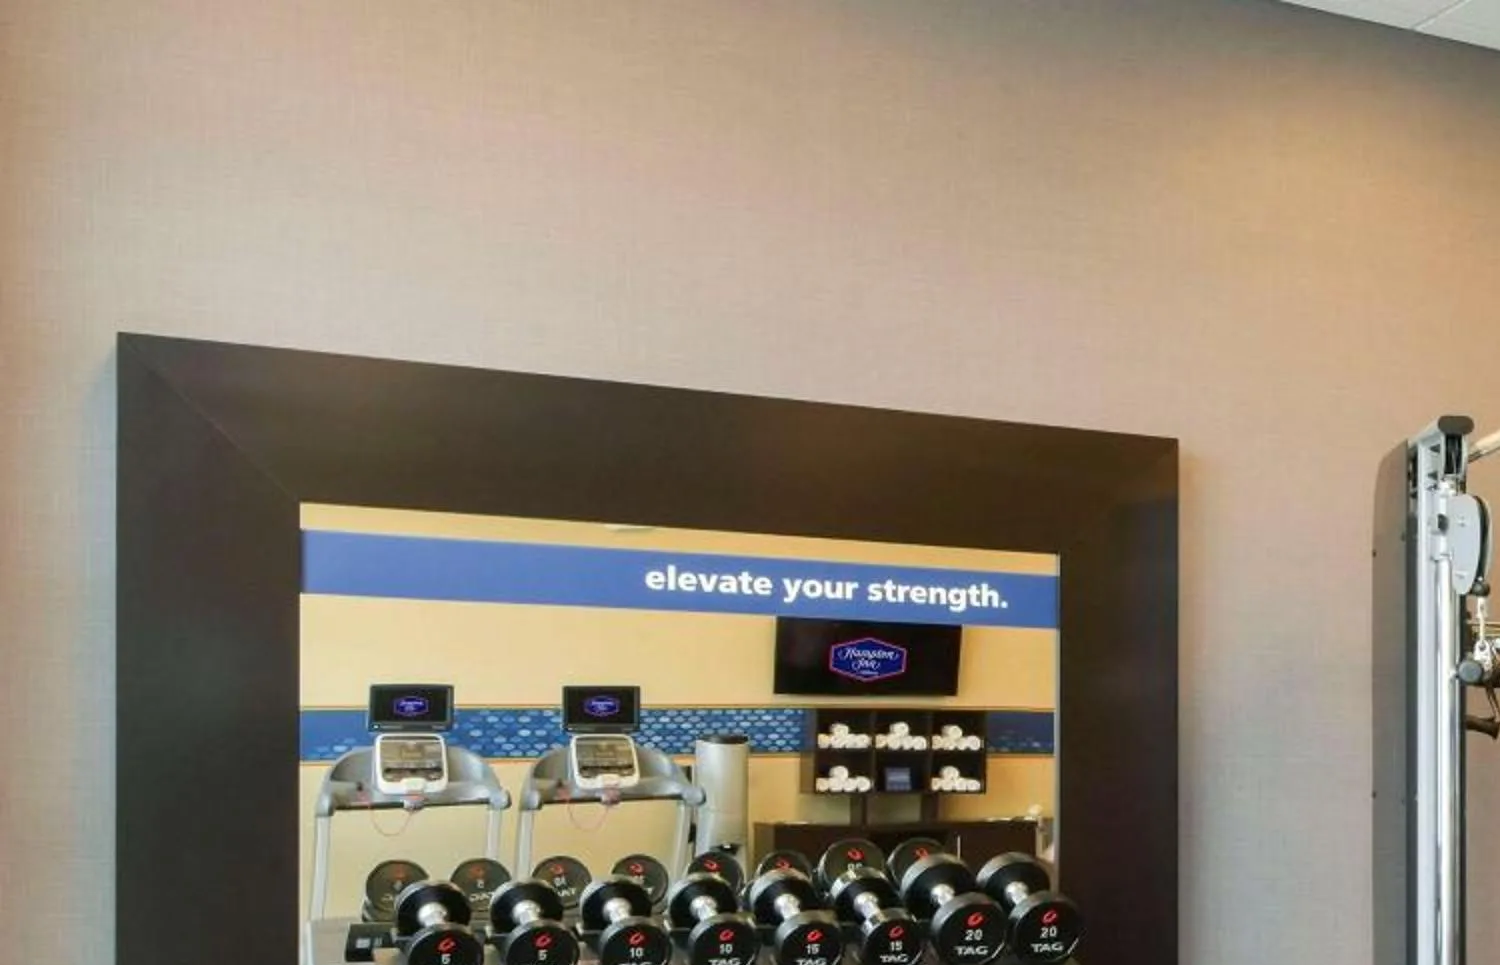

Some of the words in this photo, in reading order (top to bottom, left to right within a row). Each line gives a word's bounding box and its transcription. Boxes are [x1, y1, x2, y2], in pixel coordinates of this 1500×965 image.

[644, 564, 773, 596] elevate
[782, 576, 860, 603] your
[867, 578, 1009, 612] strength.
[965, 928, 983, 942] 20
[1040, 926, 1057, 939] 20
[630, 947, 644, 958] 10
[805, 944, 819, 955] 15
[890, 941, 902, 952] 15
[954, 944, 989, 957] TAG
[1031, 941, 1064, 954] TAG
[538, 950, 547, 960] 5
[879, 953, 909, 964] TAG
